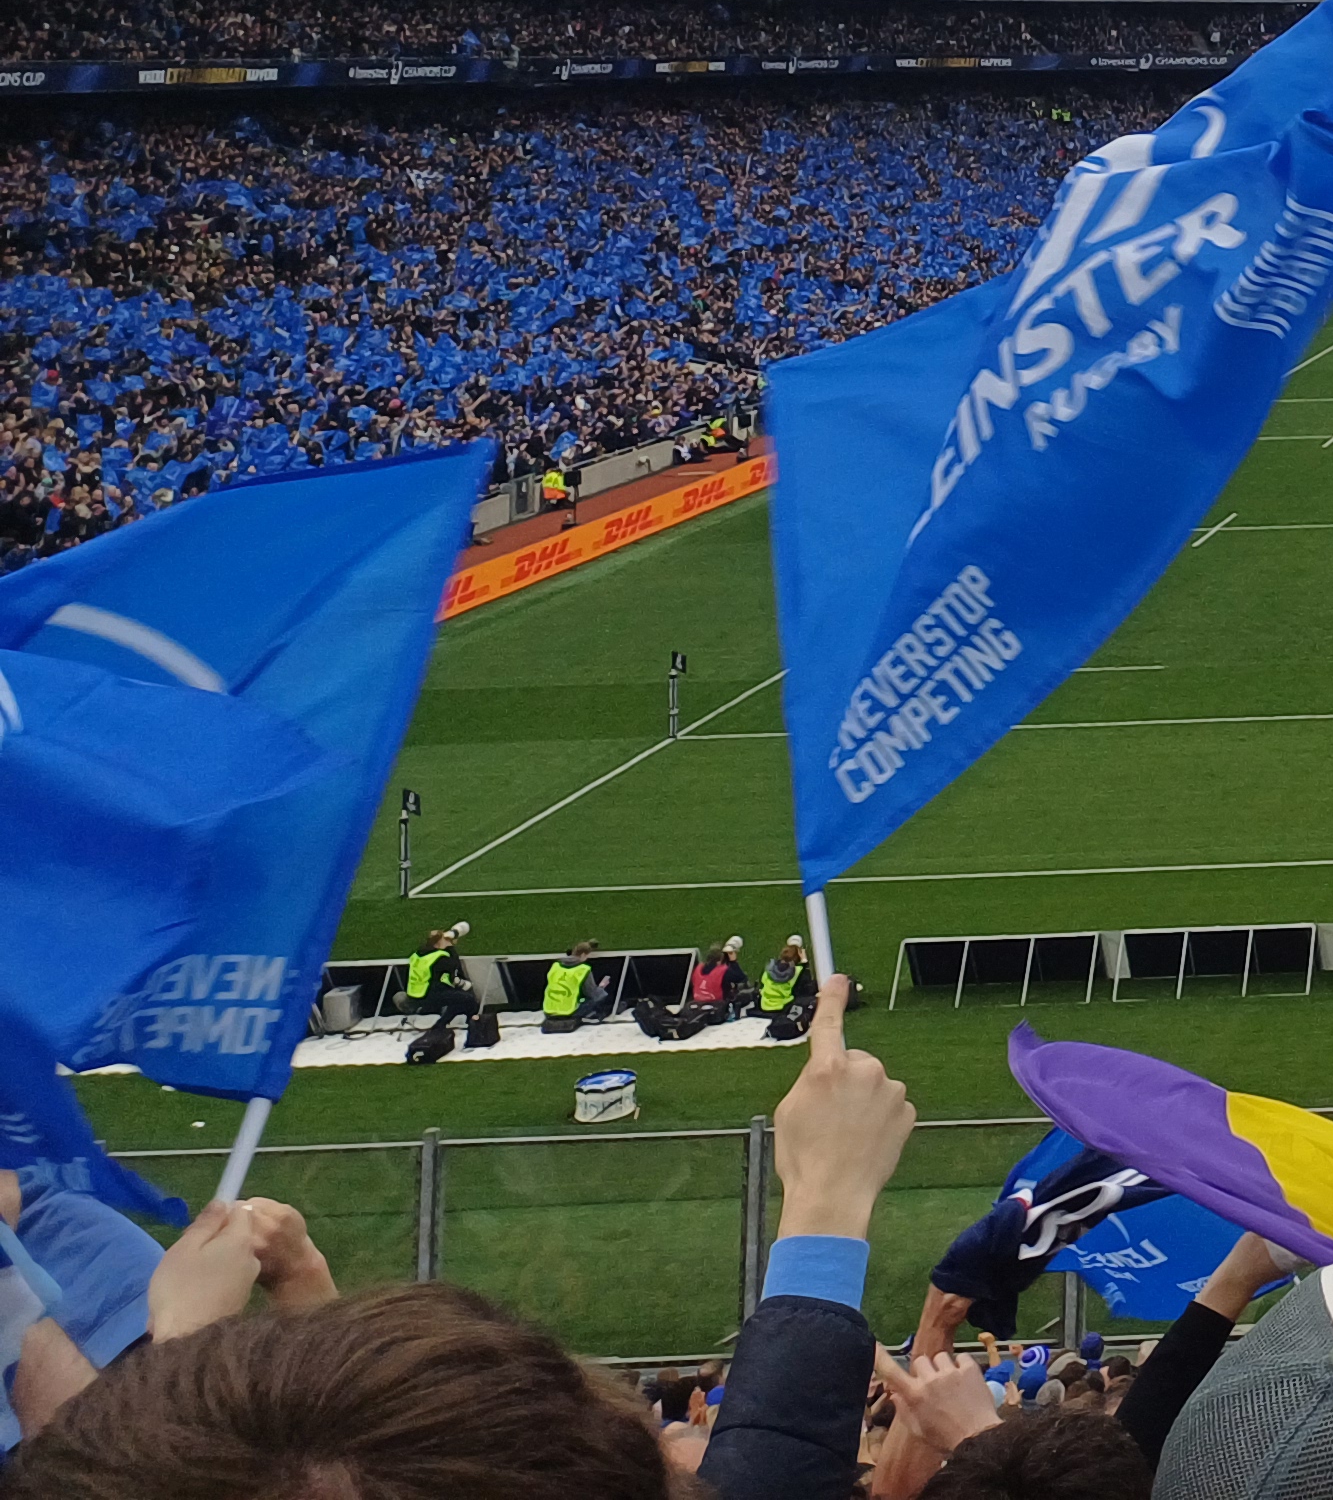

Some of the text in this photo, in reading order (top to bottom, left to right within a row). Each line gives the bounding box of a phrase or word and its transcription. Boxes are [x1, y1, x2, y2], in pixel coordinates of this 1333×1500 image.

[22, 71, 45, 86] CUP
[1024, 304, 1183, 452] RUGBY
[682, 477, 728, 514] DHL
[605, 505, 656, 546] DHL
[513, 538, 573, 583] DHL
[440, 575, 479, 612] HL
[829, 565, 995, 768] NEVERSTOP
[834, 618, 1024, 803] COMPETING
